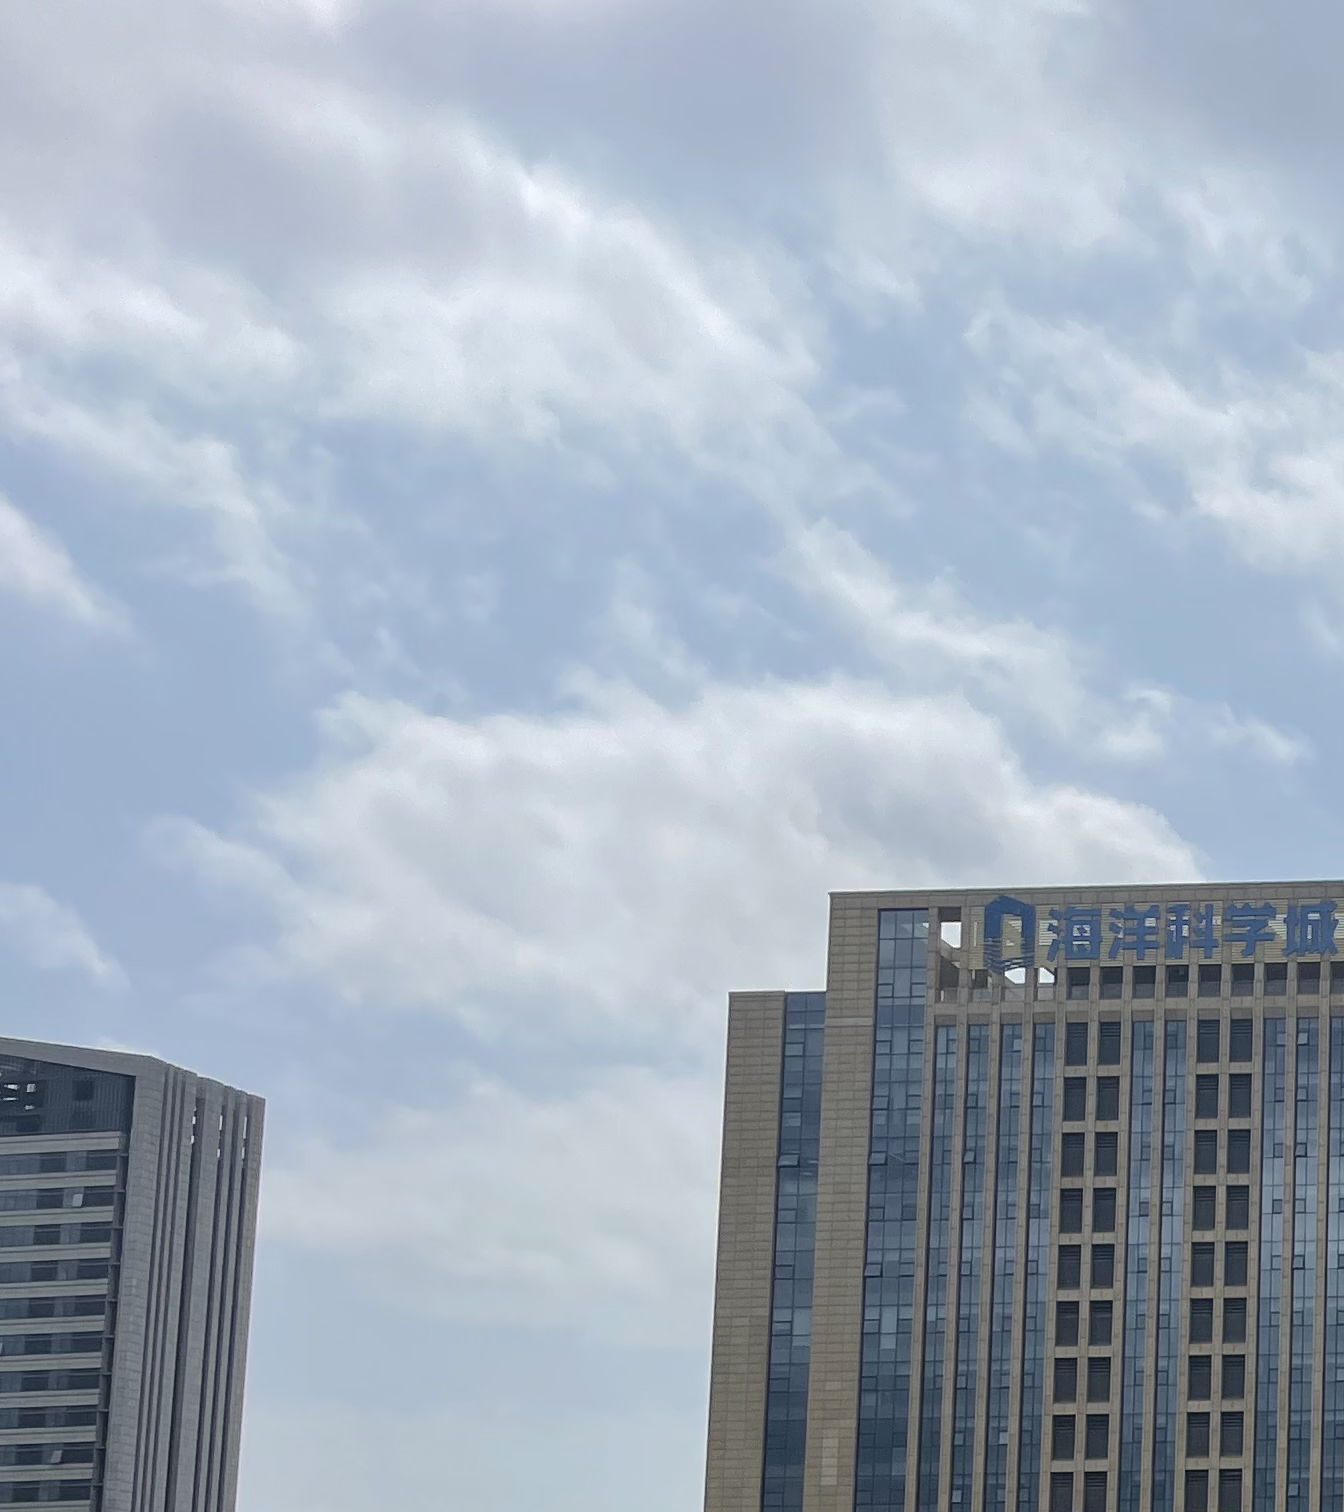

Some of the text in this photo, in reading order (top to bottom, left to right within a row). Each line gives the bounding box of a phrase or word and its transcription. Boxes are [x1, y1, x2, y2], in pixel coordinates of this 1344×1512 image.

[1046, 900, 1340, 963] 海洋科学城
